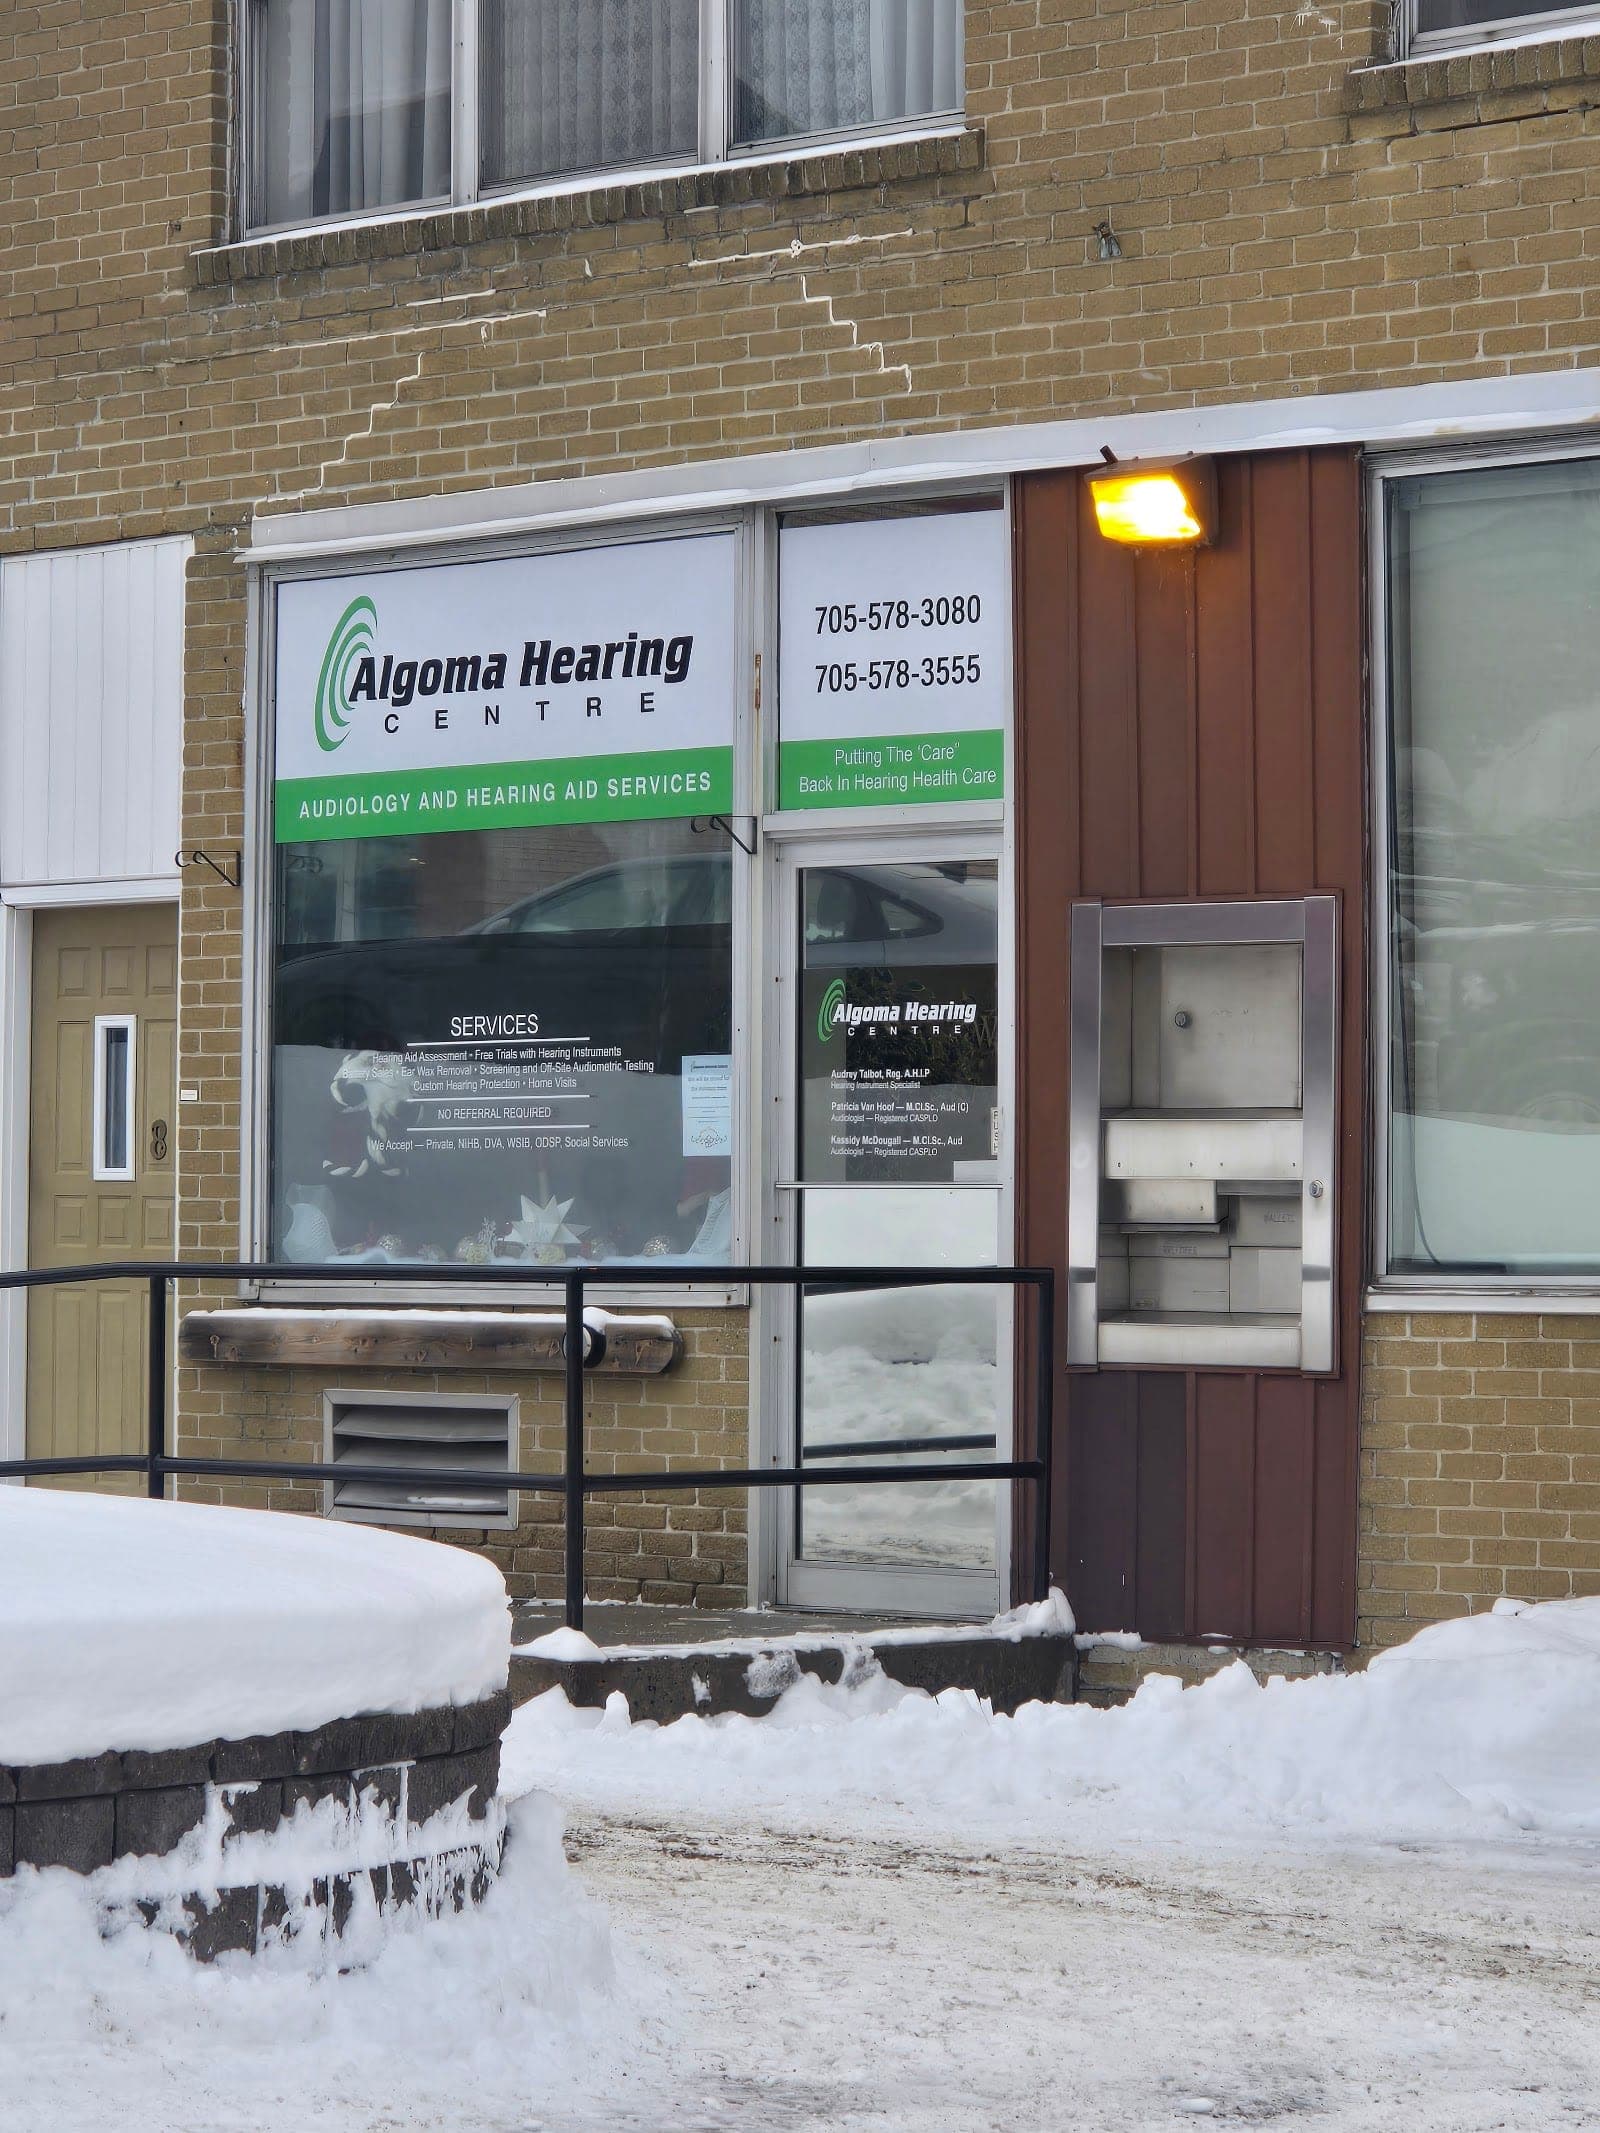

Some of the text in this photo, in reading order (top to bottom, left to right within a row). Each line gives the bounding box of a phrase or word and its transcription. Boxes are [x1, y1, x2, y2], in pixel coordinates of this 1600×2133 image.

[815, 594, 981, 634] 705-578-3080
[349, 632, 694, 706] Algoma Hearing
[815, 654, 981, 693] 705-578-3555
[835, 748, 882, 767] Putting
[886, 746, 913, 763] The
[800, 767, 996, 793] Back In Hearing Health Care
[299, 771, 713, 819] AUDIOLOGY AND HEARING AID SERVICES
[832, 1001, 977, 1025] Algoma Hearing
[450, 1014, 539, 1037] SERVICES
[372, 1045, 622, 1065] Hearing Aid Assessment Free Trials with Hearing Instruments
[401, 1066, 416, 1078] Ear
[416, 1065, 435, 1077] Wax
[436, 1063, 473, 1077] Removal
[479, 1062, 521, 1077] Screening
[522, 1062, 538, 1075] and
[540, 1061, 572, 1074] Off-Site
[572, 1059, 622, 1073] Audiometric
[623, 1058, 655, 1073] Testing
[859, 1068, 884, 1080] Talbot,
[413, 1076, 578, 1093] Custom Hearing Protection Home Visits
[438, 1107, 551, 1120] NO REFERRAL REQUIRED
[831, 1102, 859, 1111] Patricia
[860, 1101, 875, 1112] Van
[876, 1101, 895, 1112] Hoof
[940, 1101, 956, 1112] Aud
[386, 1139, 413, 1152] Accept
[426, 1139, 456, 1150] Private,
[458, 1138, 482, 1150] NIHB,
[484, 1137, 505, 1150] DVA,
[507, 1137, 533, 1149] WSIB,
[535, 1136, 563, 1148] ODSP,
[564, 1136, 591, 1148] Social
[592, 1135, 629, 1148] Services
[830, 1135, 860, 1146] Kassidy
[947, 1135, 963, 1145] Aud
